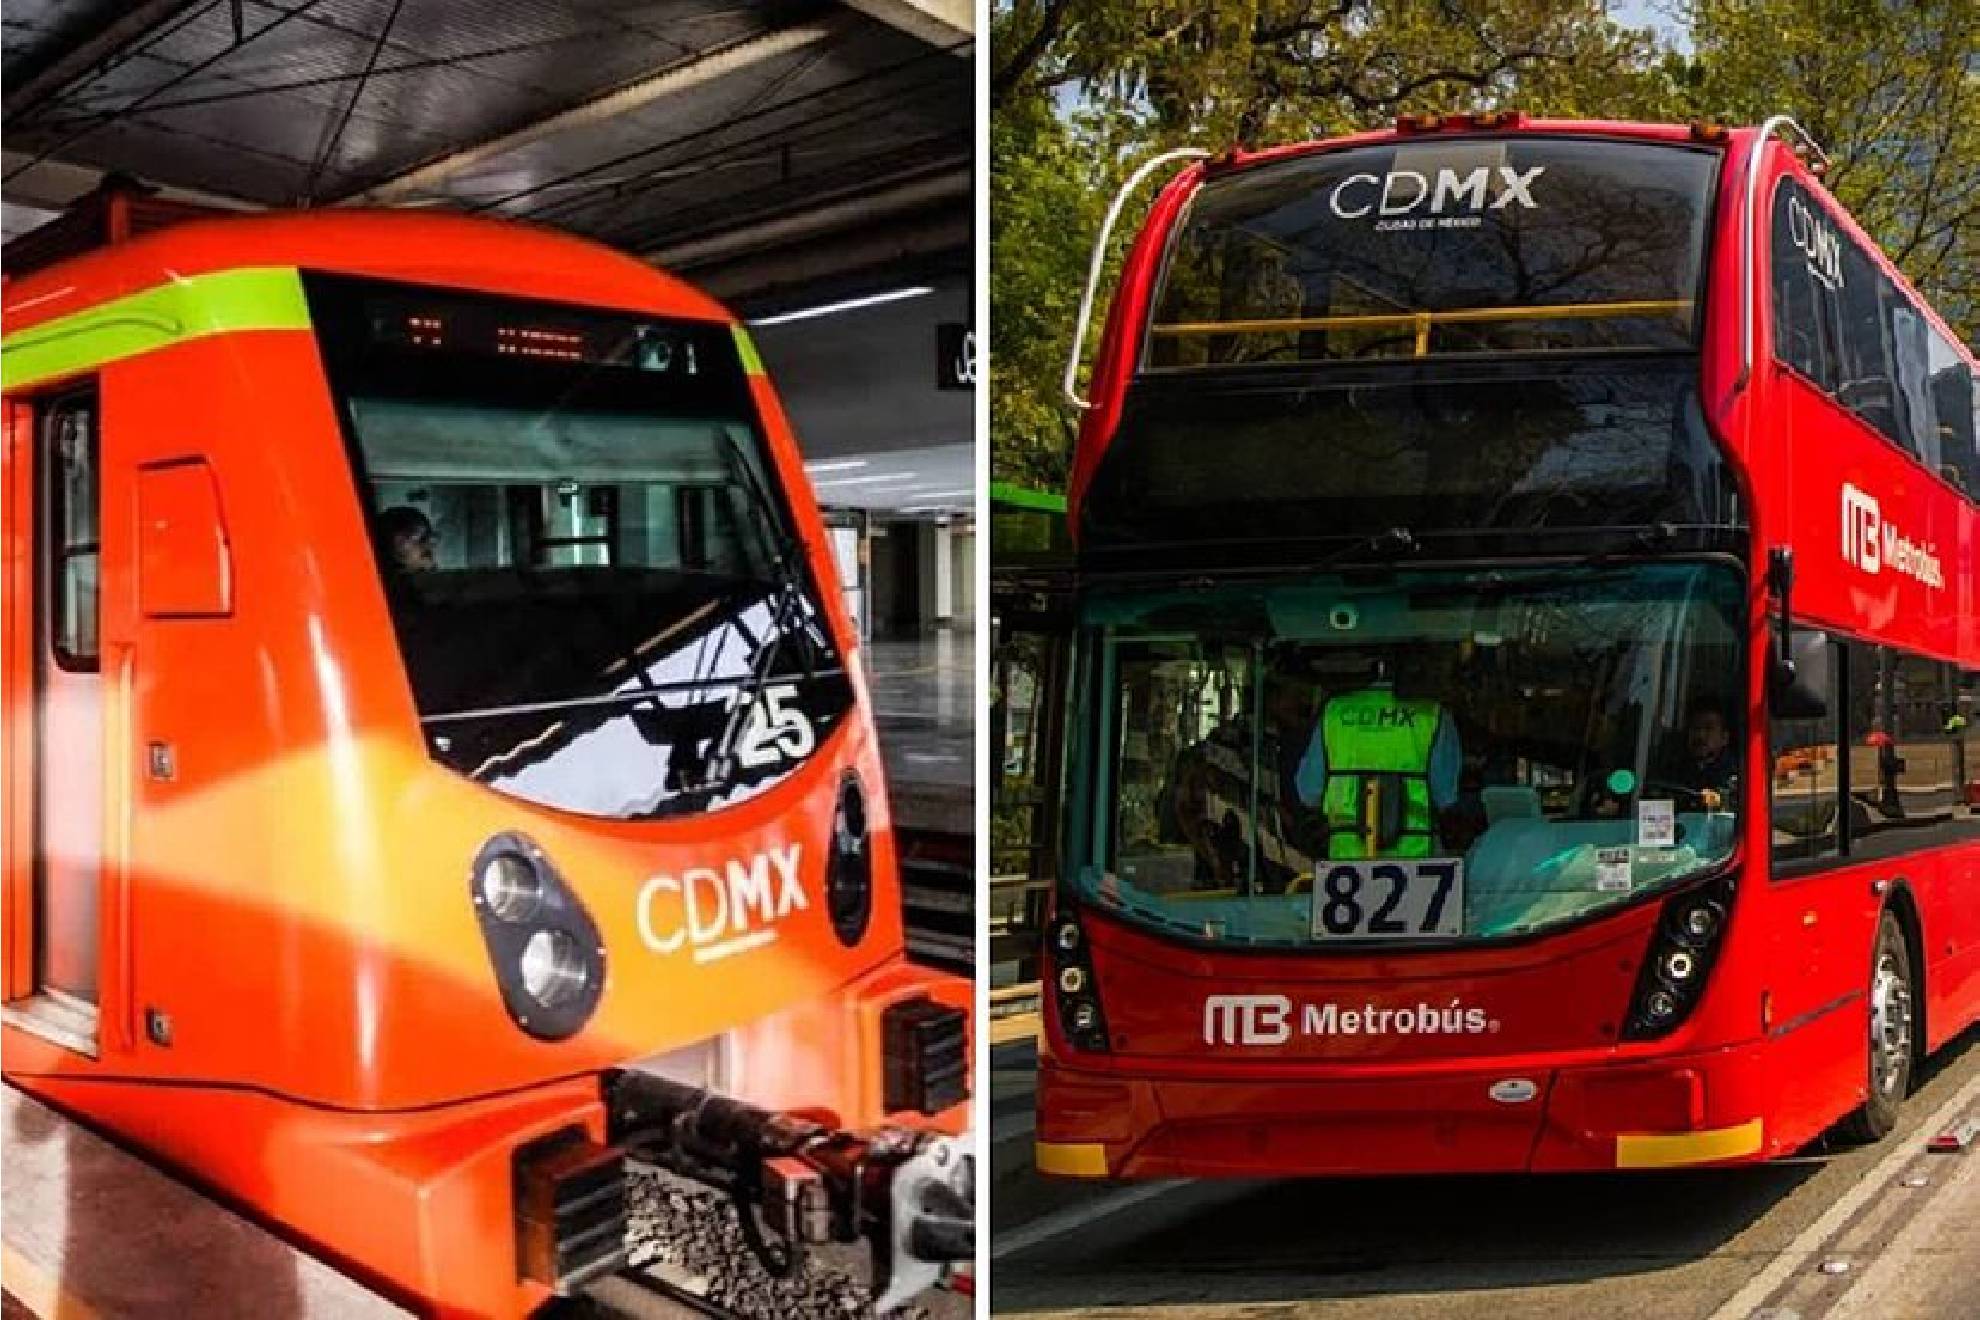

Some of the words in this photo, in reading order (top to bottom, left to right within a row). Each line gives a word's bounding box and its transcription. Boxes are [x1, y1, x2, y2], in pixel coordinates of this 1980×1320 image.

[1329, 165, 1546, 219] CDMX
[1788, 195, 1845, 288] CDMX
[636, 842, 810, 954] CDMX
[1322, 864, 1456, 934] 827
[1303, 998, 1487, 1034] Metrobús
